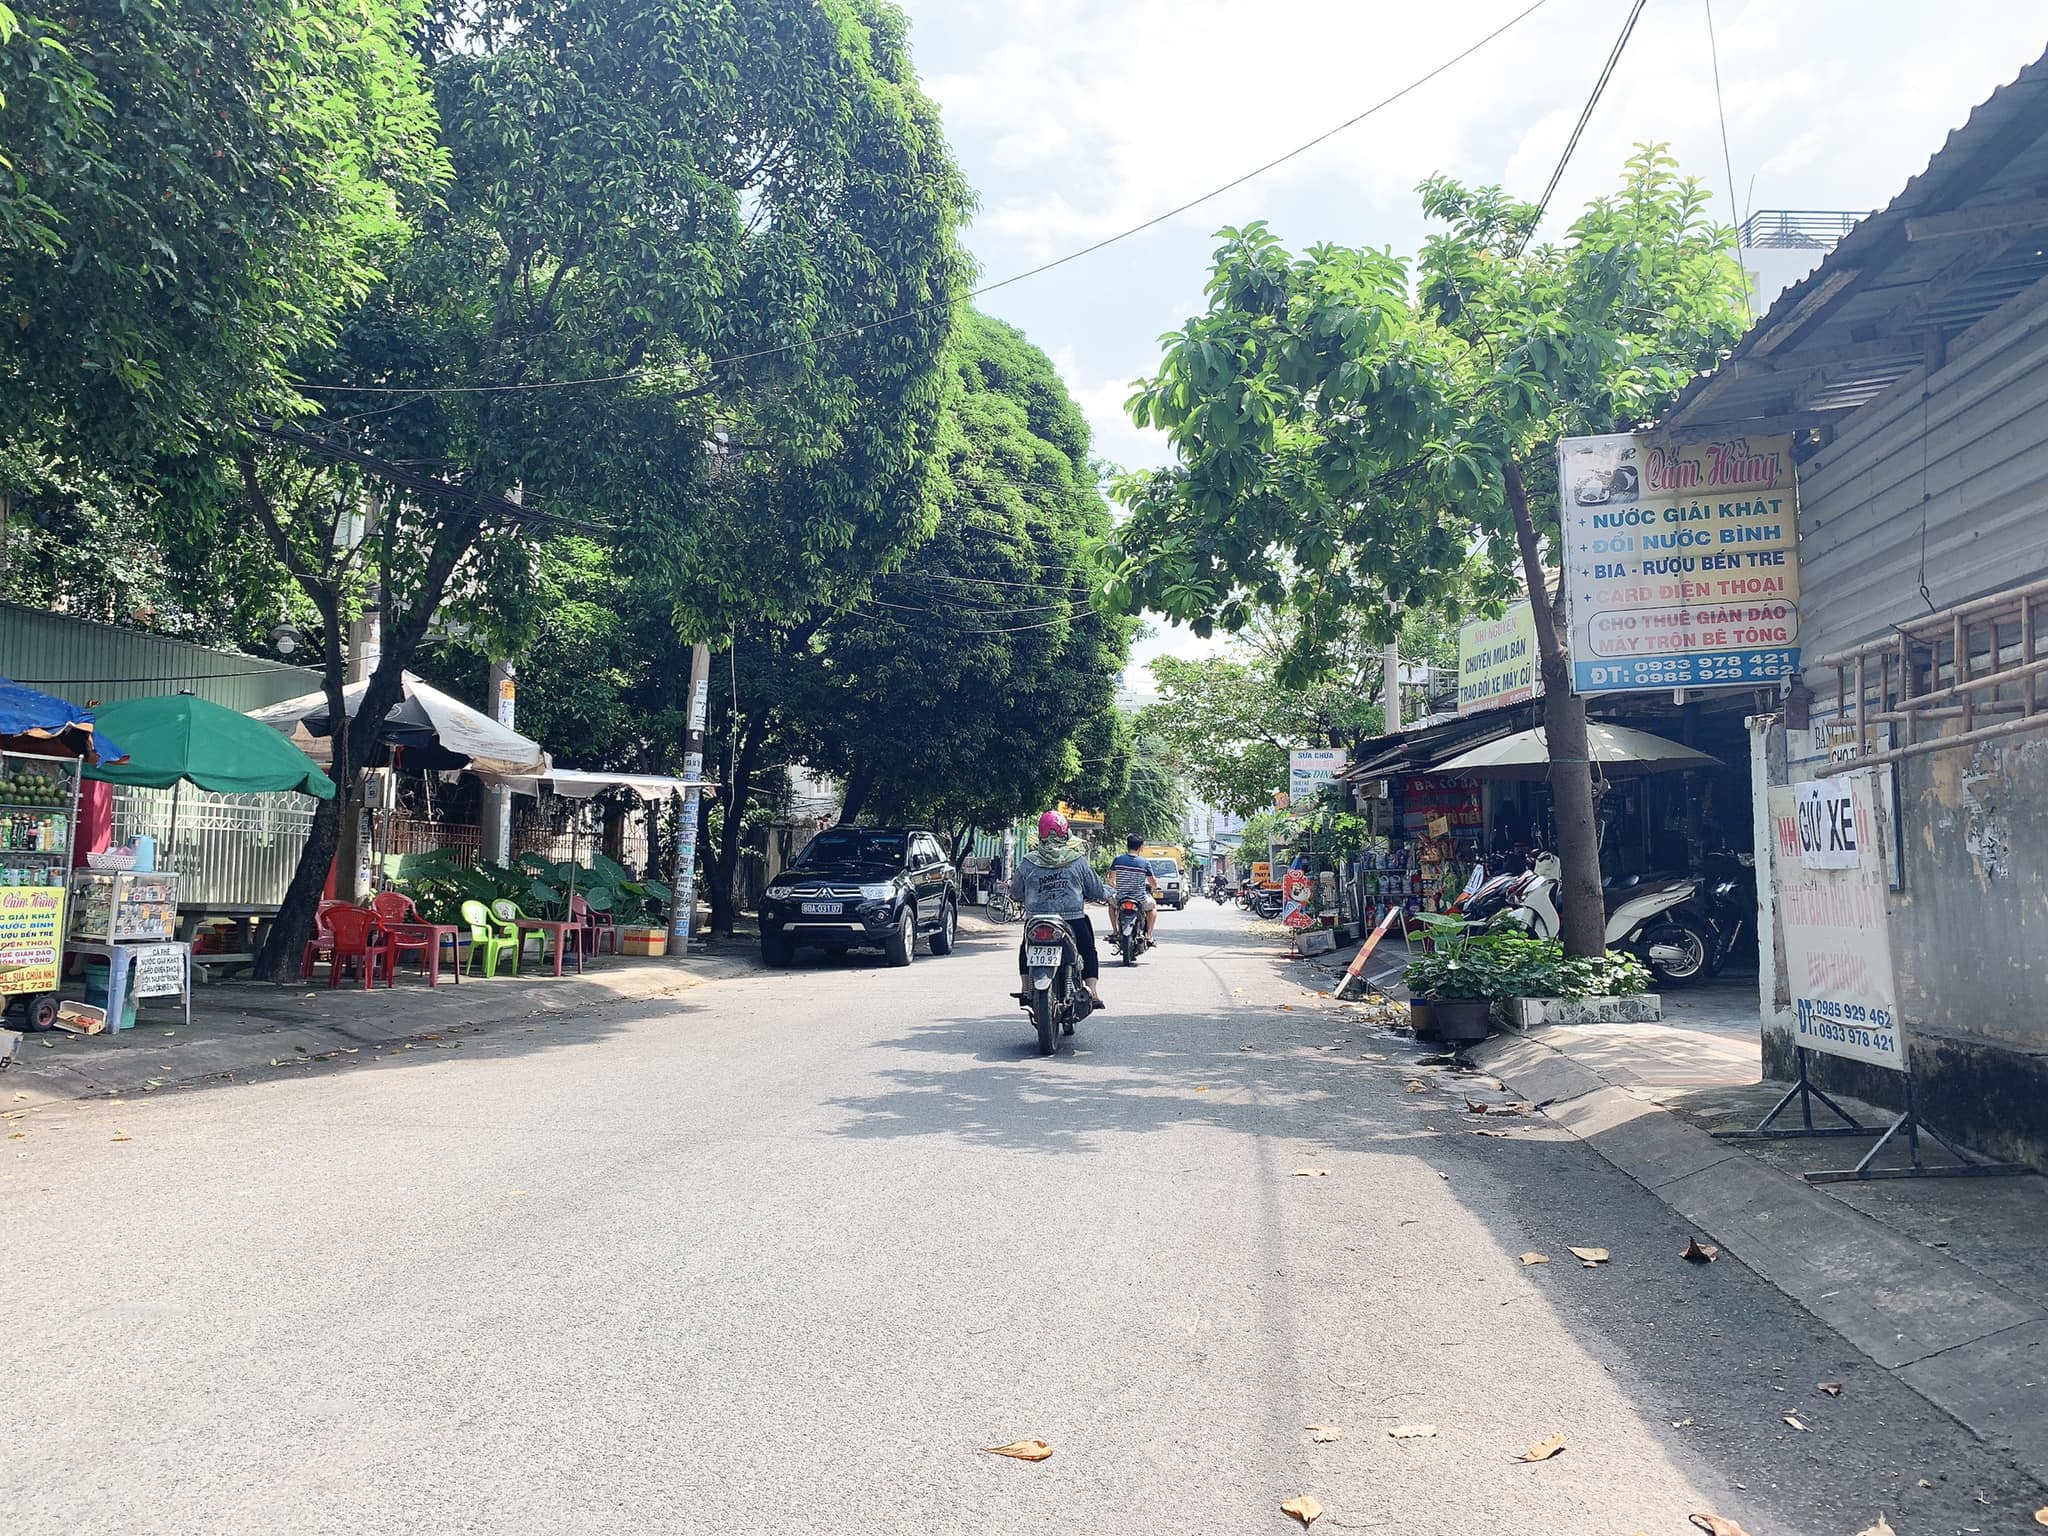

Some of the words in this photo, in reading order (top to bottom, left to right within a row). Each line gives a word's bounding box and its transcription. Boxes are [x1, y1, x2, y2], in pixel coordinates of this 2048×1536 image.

[1593, 508, 1656, 529] NƯỚC
[1663, 501, 1711, 522] GIẢI
[1718, 497, 1782, 518] KHÁT
[1592, 531, 1634, 553] ĐỔI
[1643, 528, 1711, 550] NƯỚC
[1719, 525, 1781, 544] BÌNH
[1594, 562, 1626, 579] BIA
[1642, 556, 1695, 577] RƯỢU
[1701, 549, 1740, 571] BẾN
[1747, 551, 1785, 567] TRE
[1596, 586, 1652, 604] CARD
[1659, 580, 1710, 601] ĐIỆN
[1717, 576, 1784, 596] THOẠI
[1599, 616, 1637, 632] CHO
[1641, 610, 1691, 629] THUÊ
[1697, 607, 1742, 625] GIÀN
[1493, 644, 1508, 665] MUA
[1510, 635, 1526, 659] BÁN
[1600, 635, 1640, 653] MÁY
[1644, 632, 1697, 652] TRỘN
[1702, 629, 1727, 646] BÊ
[1733, 626, 1787, 643] TÔNG
[1460, 683, 1477, 703] TRAO
[1478, 671, 1490, 697] ĐỔI
[1491, 676, 1501, 694] XE
[1502, 667, 1518, 691] MÁY
[1520, 662, 1531, 685] CŨ
[1590, 666, 1630, 685] ĐT:
[1634, 660, 1691, 672] 0933
[1698, 656, 1742, 668] 978
[1748, 653, 1790, 665] 421
[1635, 672, 1692, 684] 0985
[1699, 668, 1743, 680] 929
[1750, 665, 1794, 676] 462
[1799, 789, 1821, 852] GIỮ
[1827, 798, 1856, 851] XE
[1816, 1000, 1841, 1017] 0985
[1844, 1004, 1866, 1021] 929
[1869, 1008, 1893, 1028] 462
[1820, 1023, 1845, 1042] 0933
[1848, 1028, 1870, 1047] 978
[1873, 1033, 1894, 1052] 421
